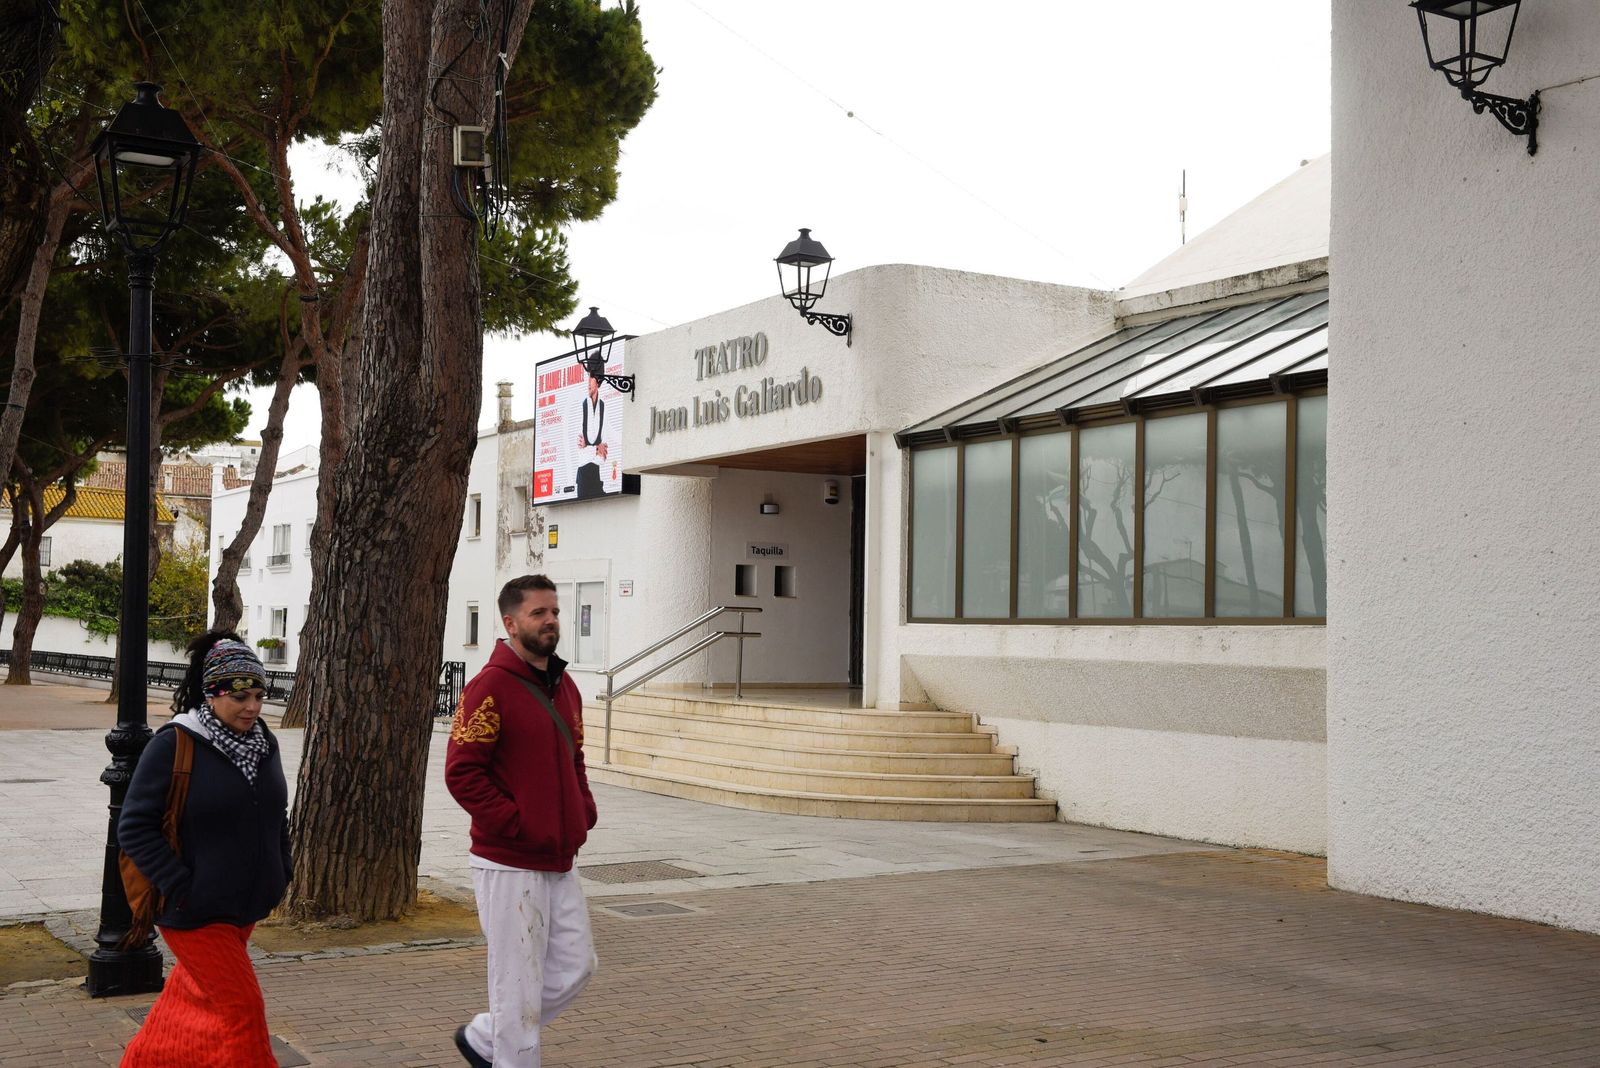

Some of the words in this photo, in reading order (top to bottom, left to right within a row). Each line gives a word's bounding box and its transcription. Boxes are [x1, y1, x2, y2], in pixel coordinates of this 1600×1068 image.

[694, 332, 768, 381] TEATRO
[646, 406, 688, 444] Juan
[693, 389, 730, 427] Luis
[734, 366, 822, 419] Galiardo
[751, 546, 783, 556] Taquilla
